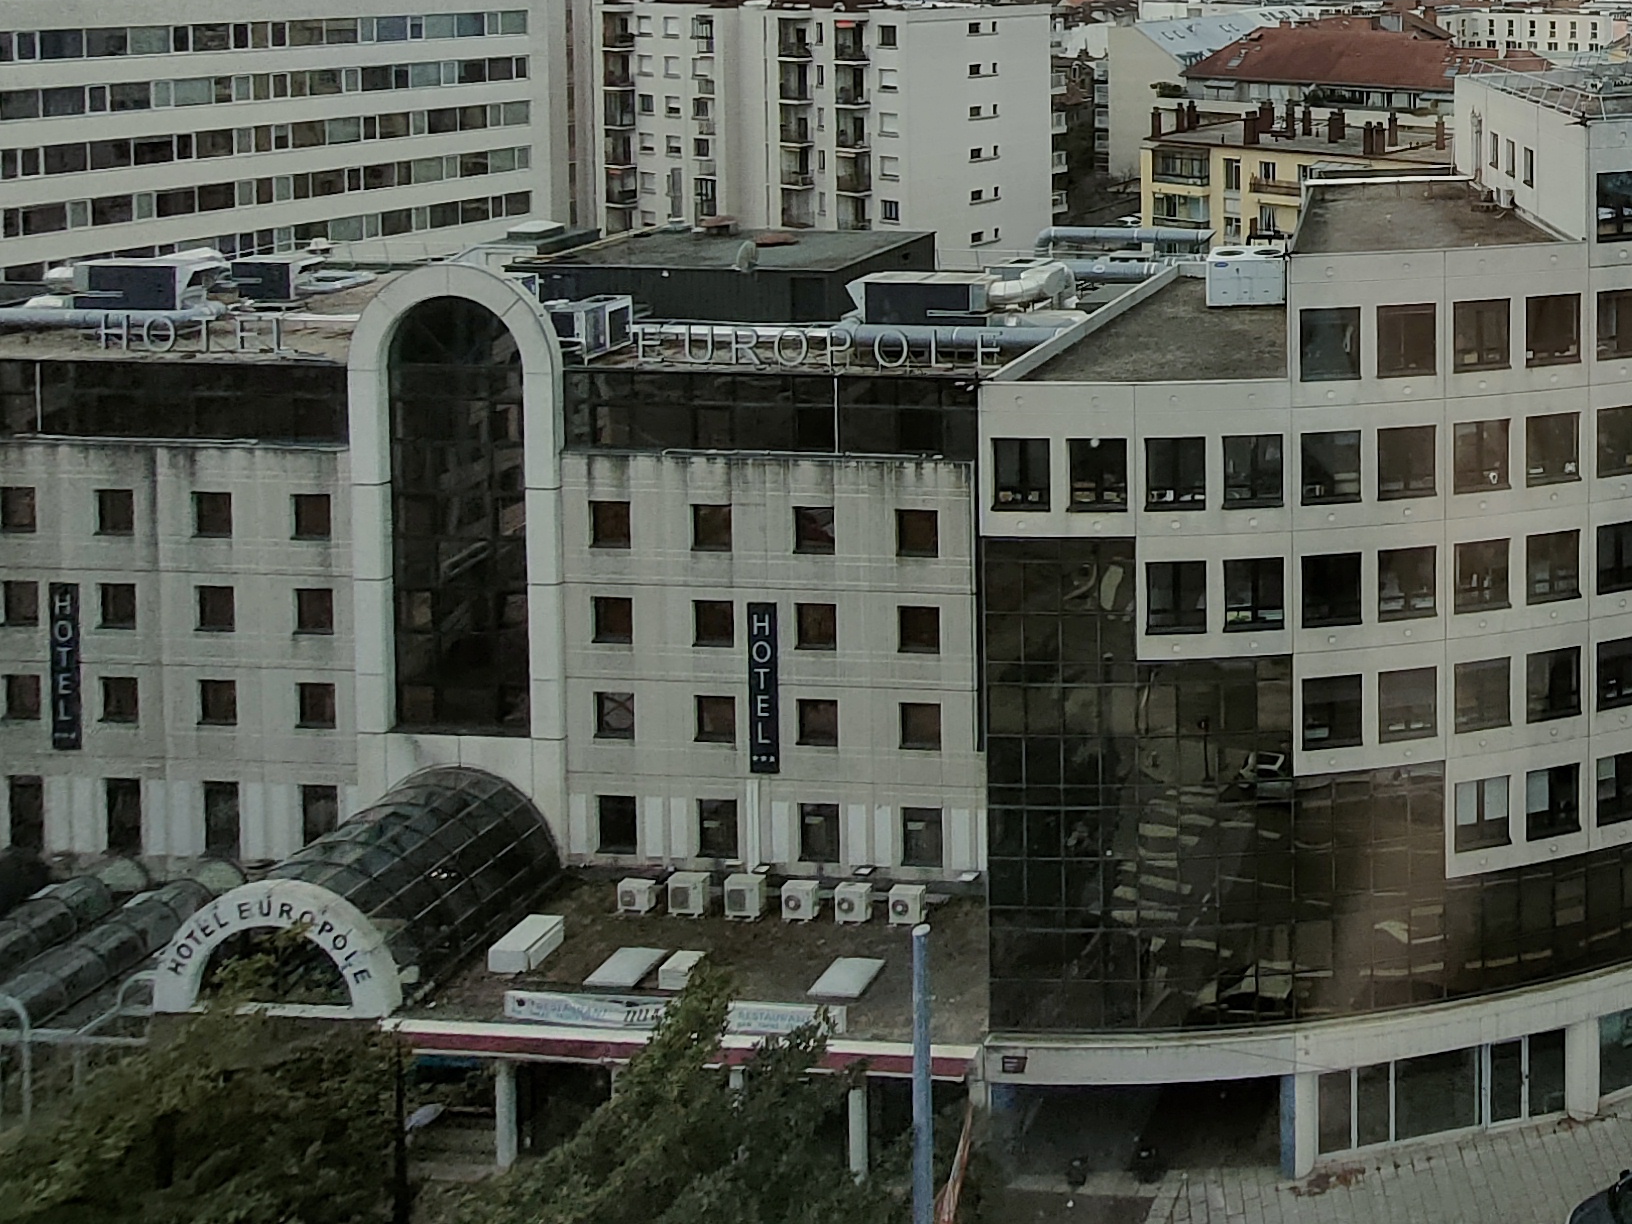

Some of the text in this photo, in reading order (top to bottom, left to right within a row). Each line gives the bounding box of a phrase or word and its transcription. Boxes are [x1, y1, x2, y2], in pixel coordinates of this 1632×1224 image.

[101, 314, 1003, 371] HOTEL EUROPOLE
[54, 593, 73, 721] HOTEL
[752, 614, 772, 744] HOTEL
[167, 912, 229, 975] HOTEL
